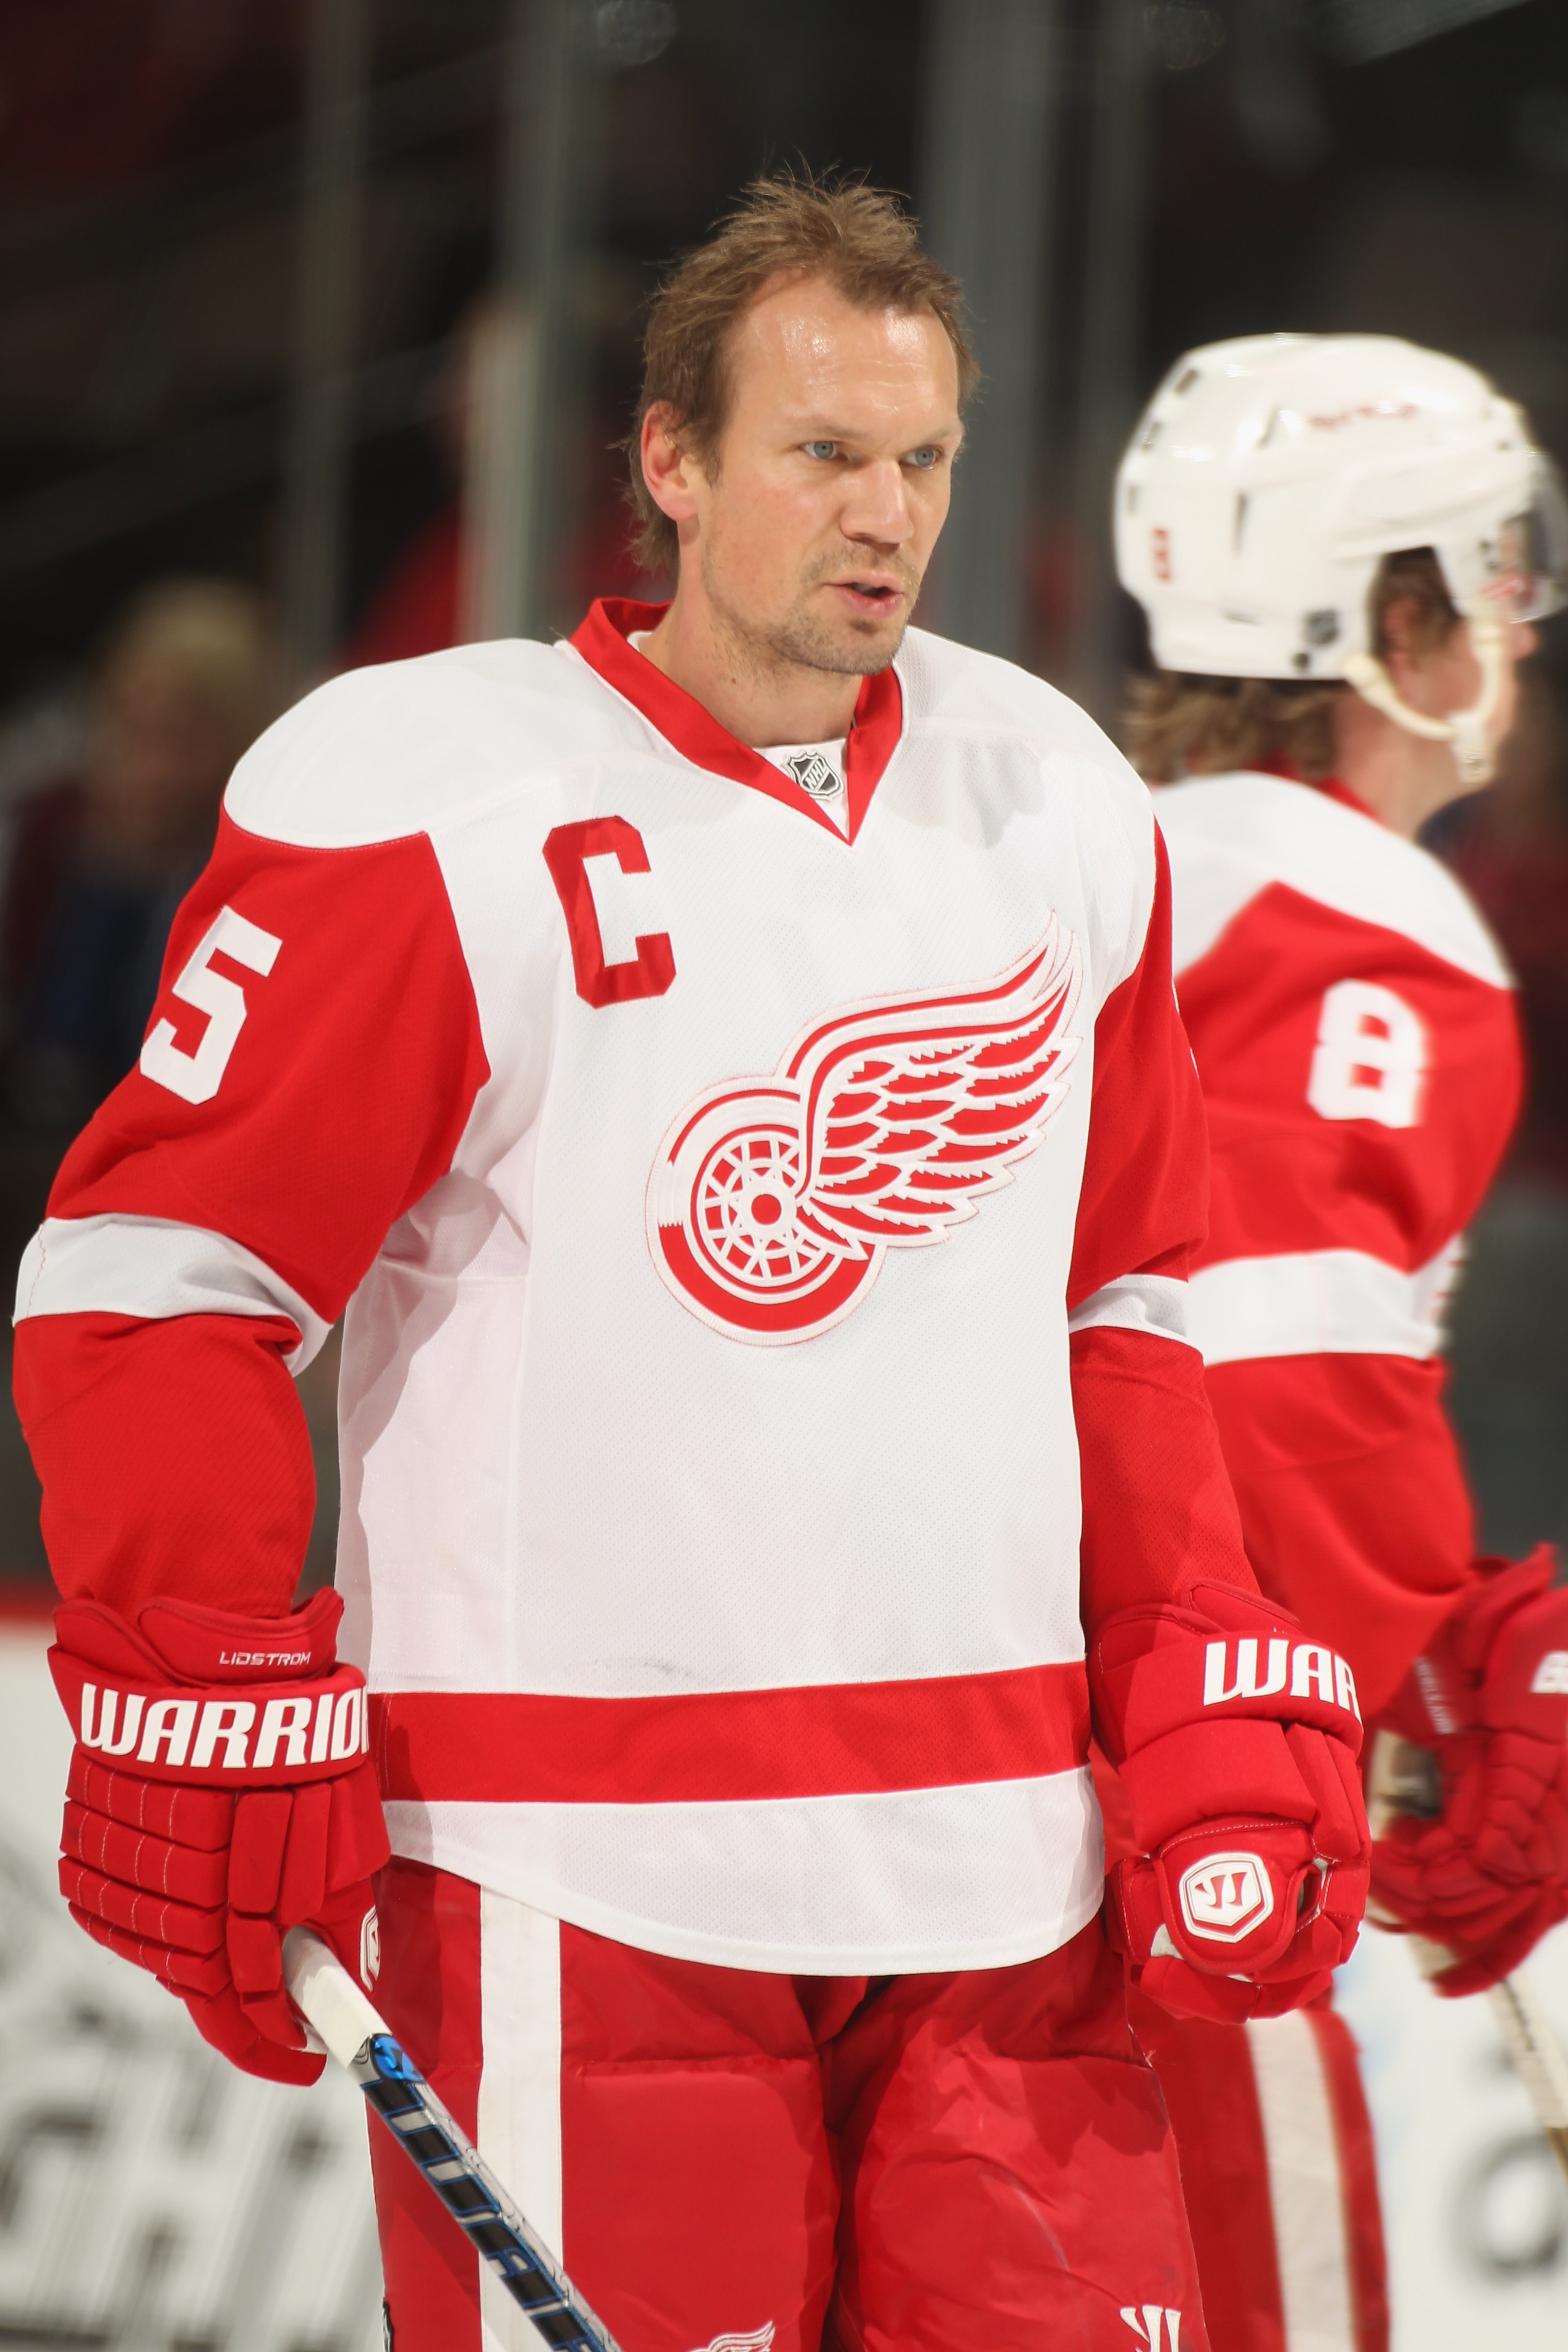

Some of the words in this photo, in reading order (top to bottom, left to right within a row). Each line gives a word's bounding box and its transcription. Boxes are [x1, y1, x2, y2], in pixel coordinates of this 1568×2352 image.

[804, 760, 827, 791] NHL
[542, 815, 676, 1009] C
[140, 905, 282, 1105] 5
[1307, 978, 1429, 1129] 8
[219, 1651, 311, 1666] LIDSTROM
